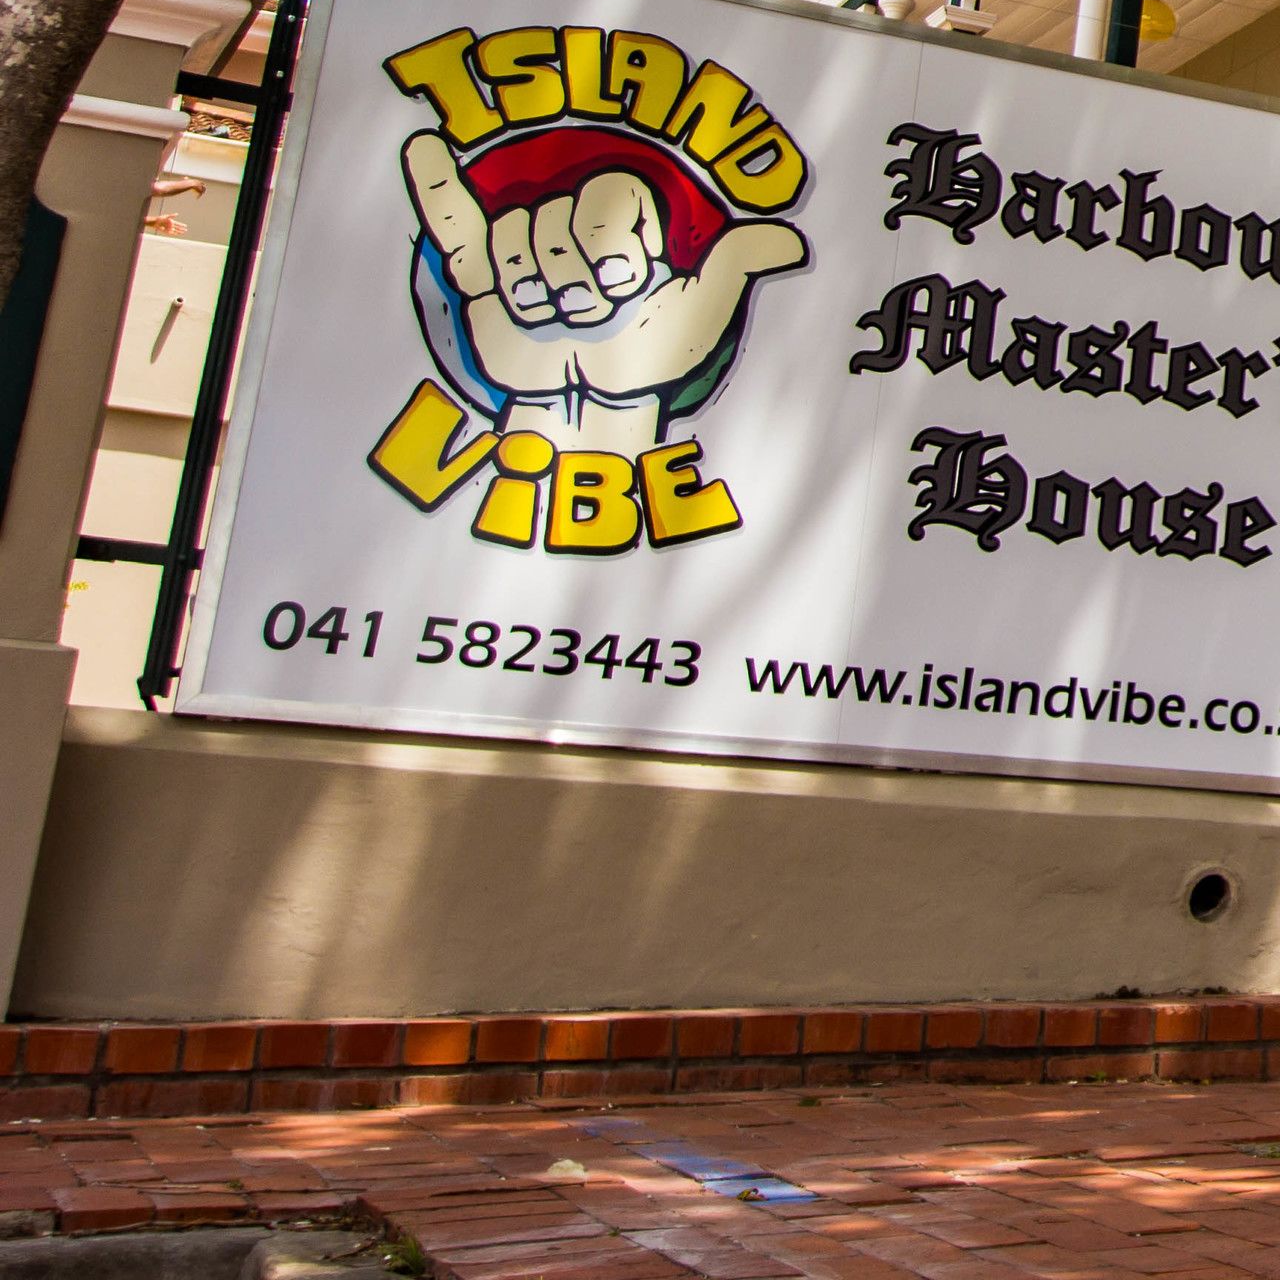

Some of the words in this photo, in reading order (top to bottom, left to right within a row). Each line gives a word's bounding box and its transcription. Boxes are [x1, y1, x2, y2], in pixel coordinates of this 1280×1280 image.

[383, 26, 809, 214] ISLAND
[907, 426, 1278, 568] House
[263, 600, 384, 658] 041
[416, 615, 702, 687] 5823443
